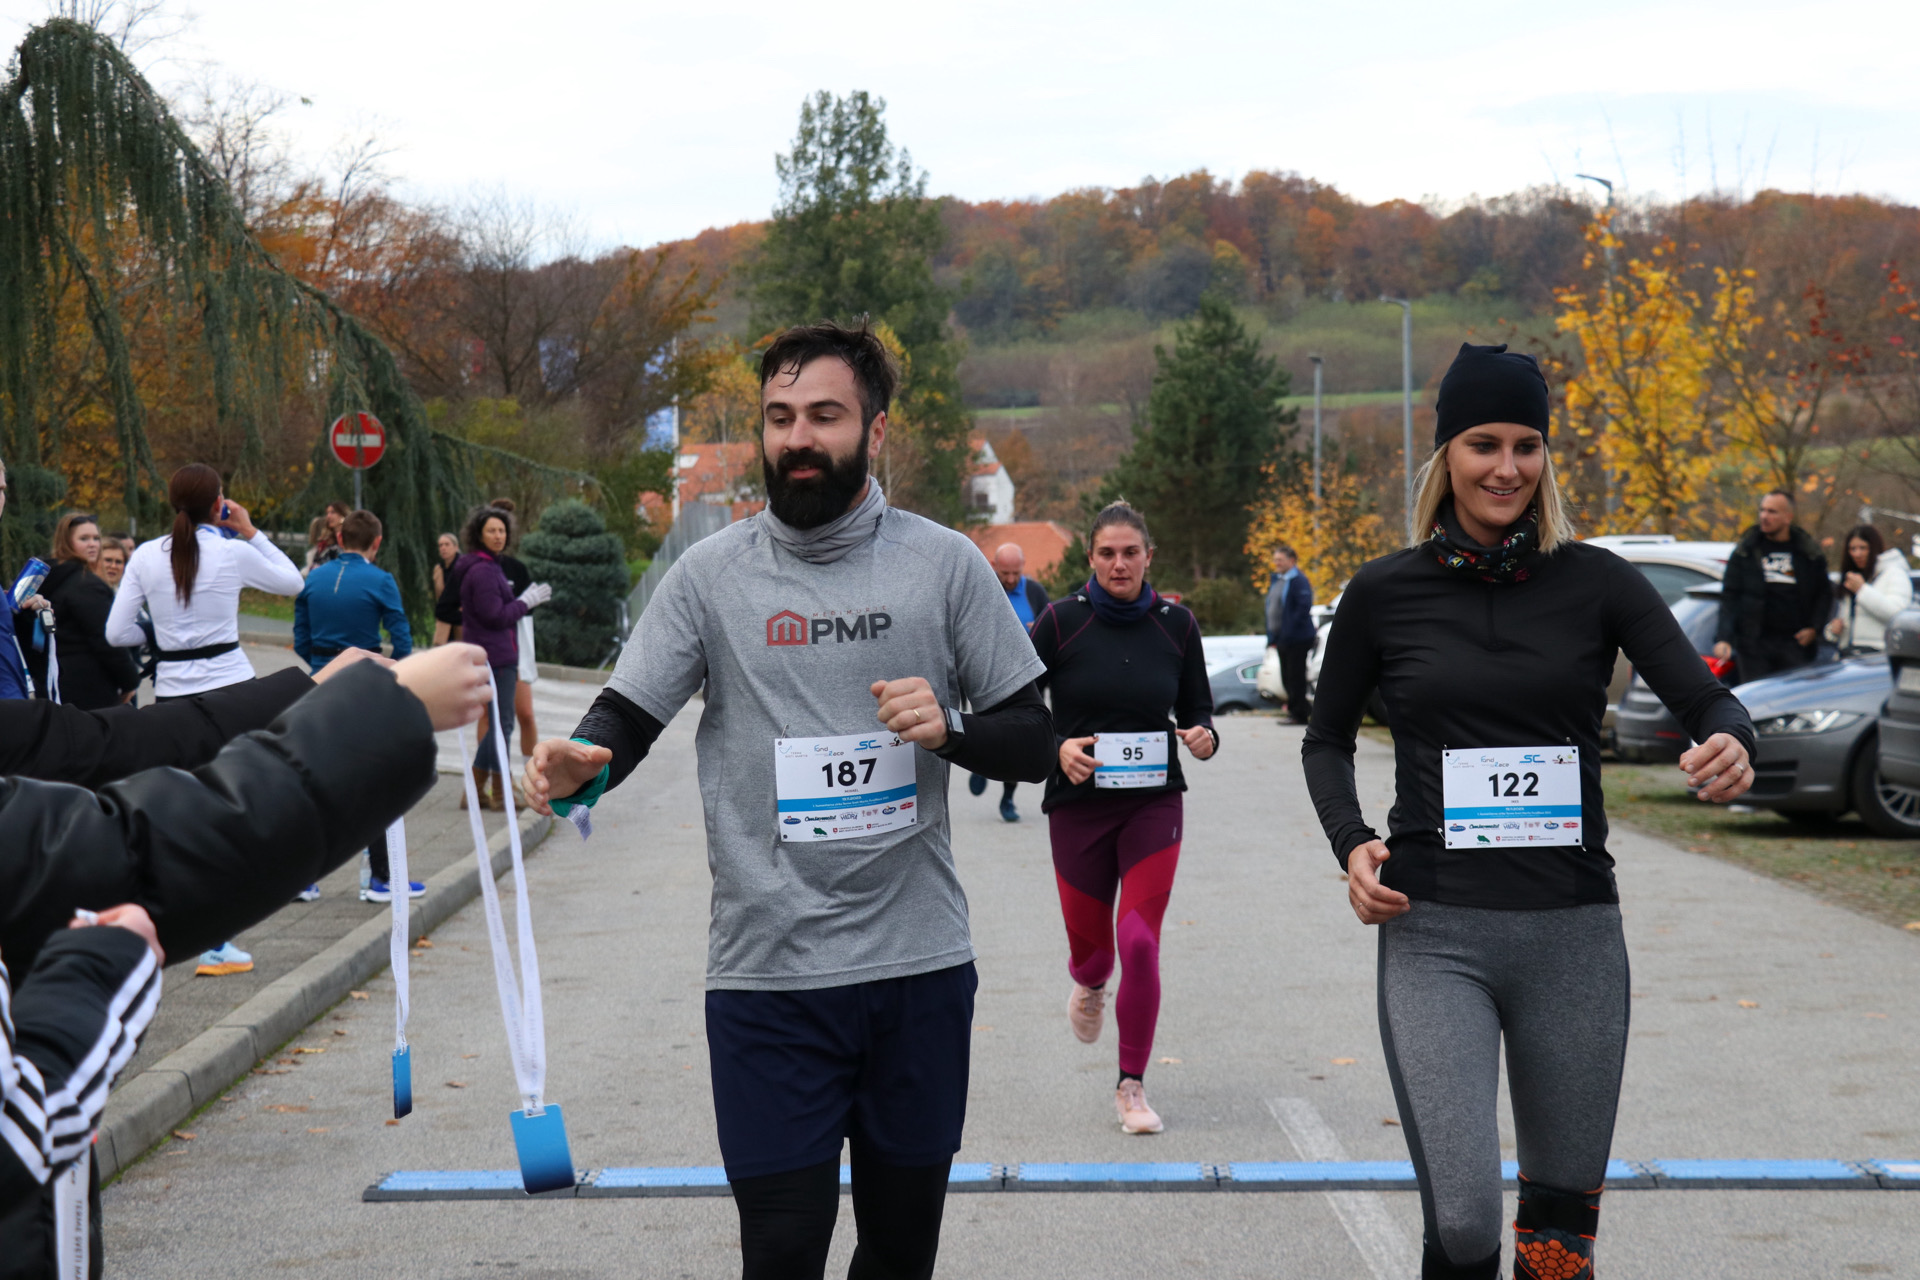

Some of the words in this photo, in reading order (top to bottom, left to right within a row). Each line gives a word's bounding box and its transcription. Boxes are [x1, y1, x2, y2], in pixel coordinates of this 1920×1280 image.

[811, 612, 892, 645] PMP
[1122, 747, 1144, 761] 95
[822, 757, 878, 788] 187
[1488, 771, 1539, 797] 122
[75, 1199, 83, 1232] TERME
[74, 1236, 83, 1263] SVETI
